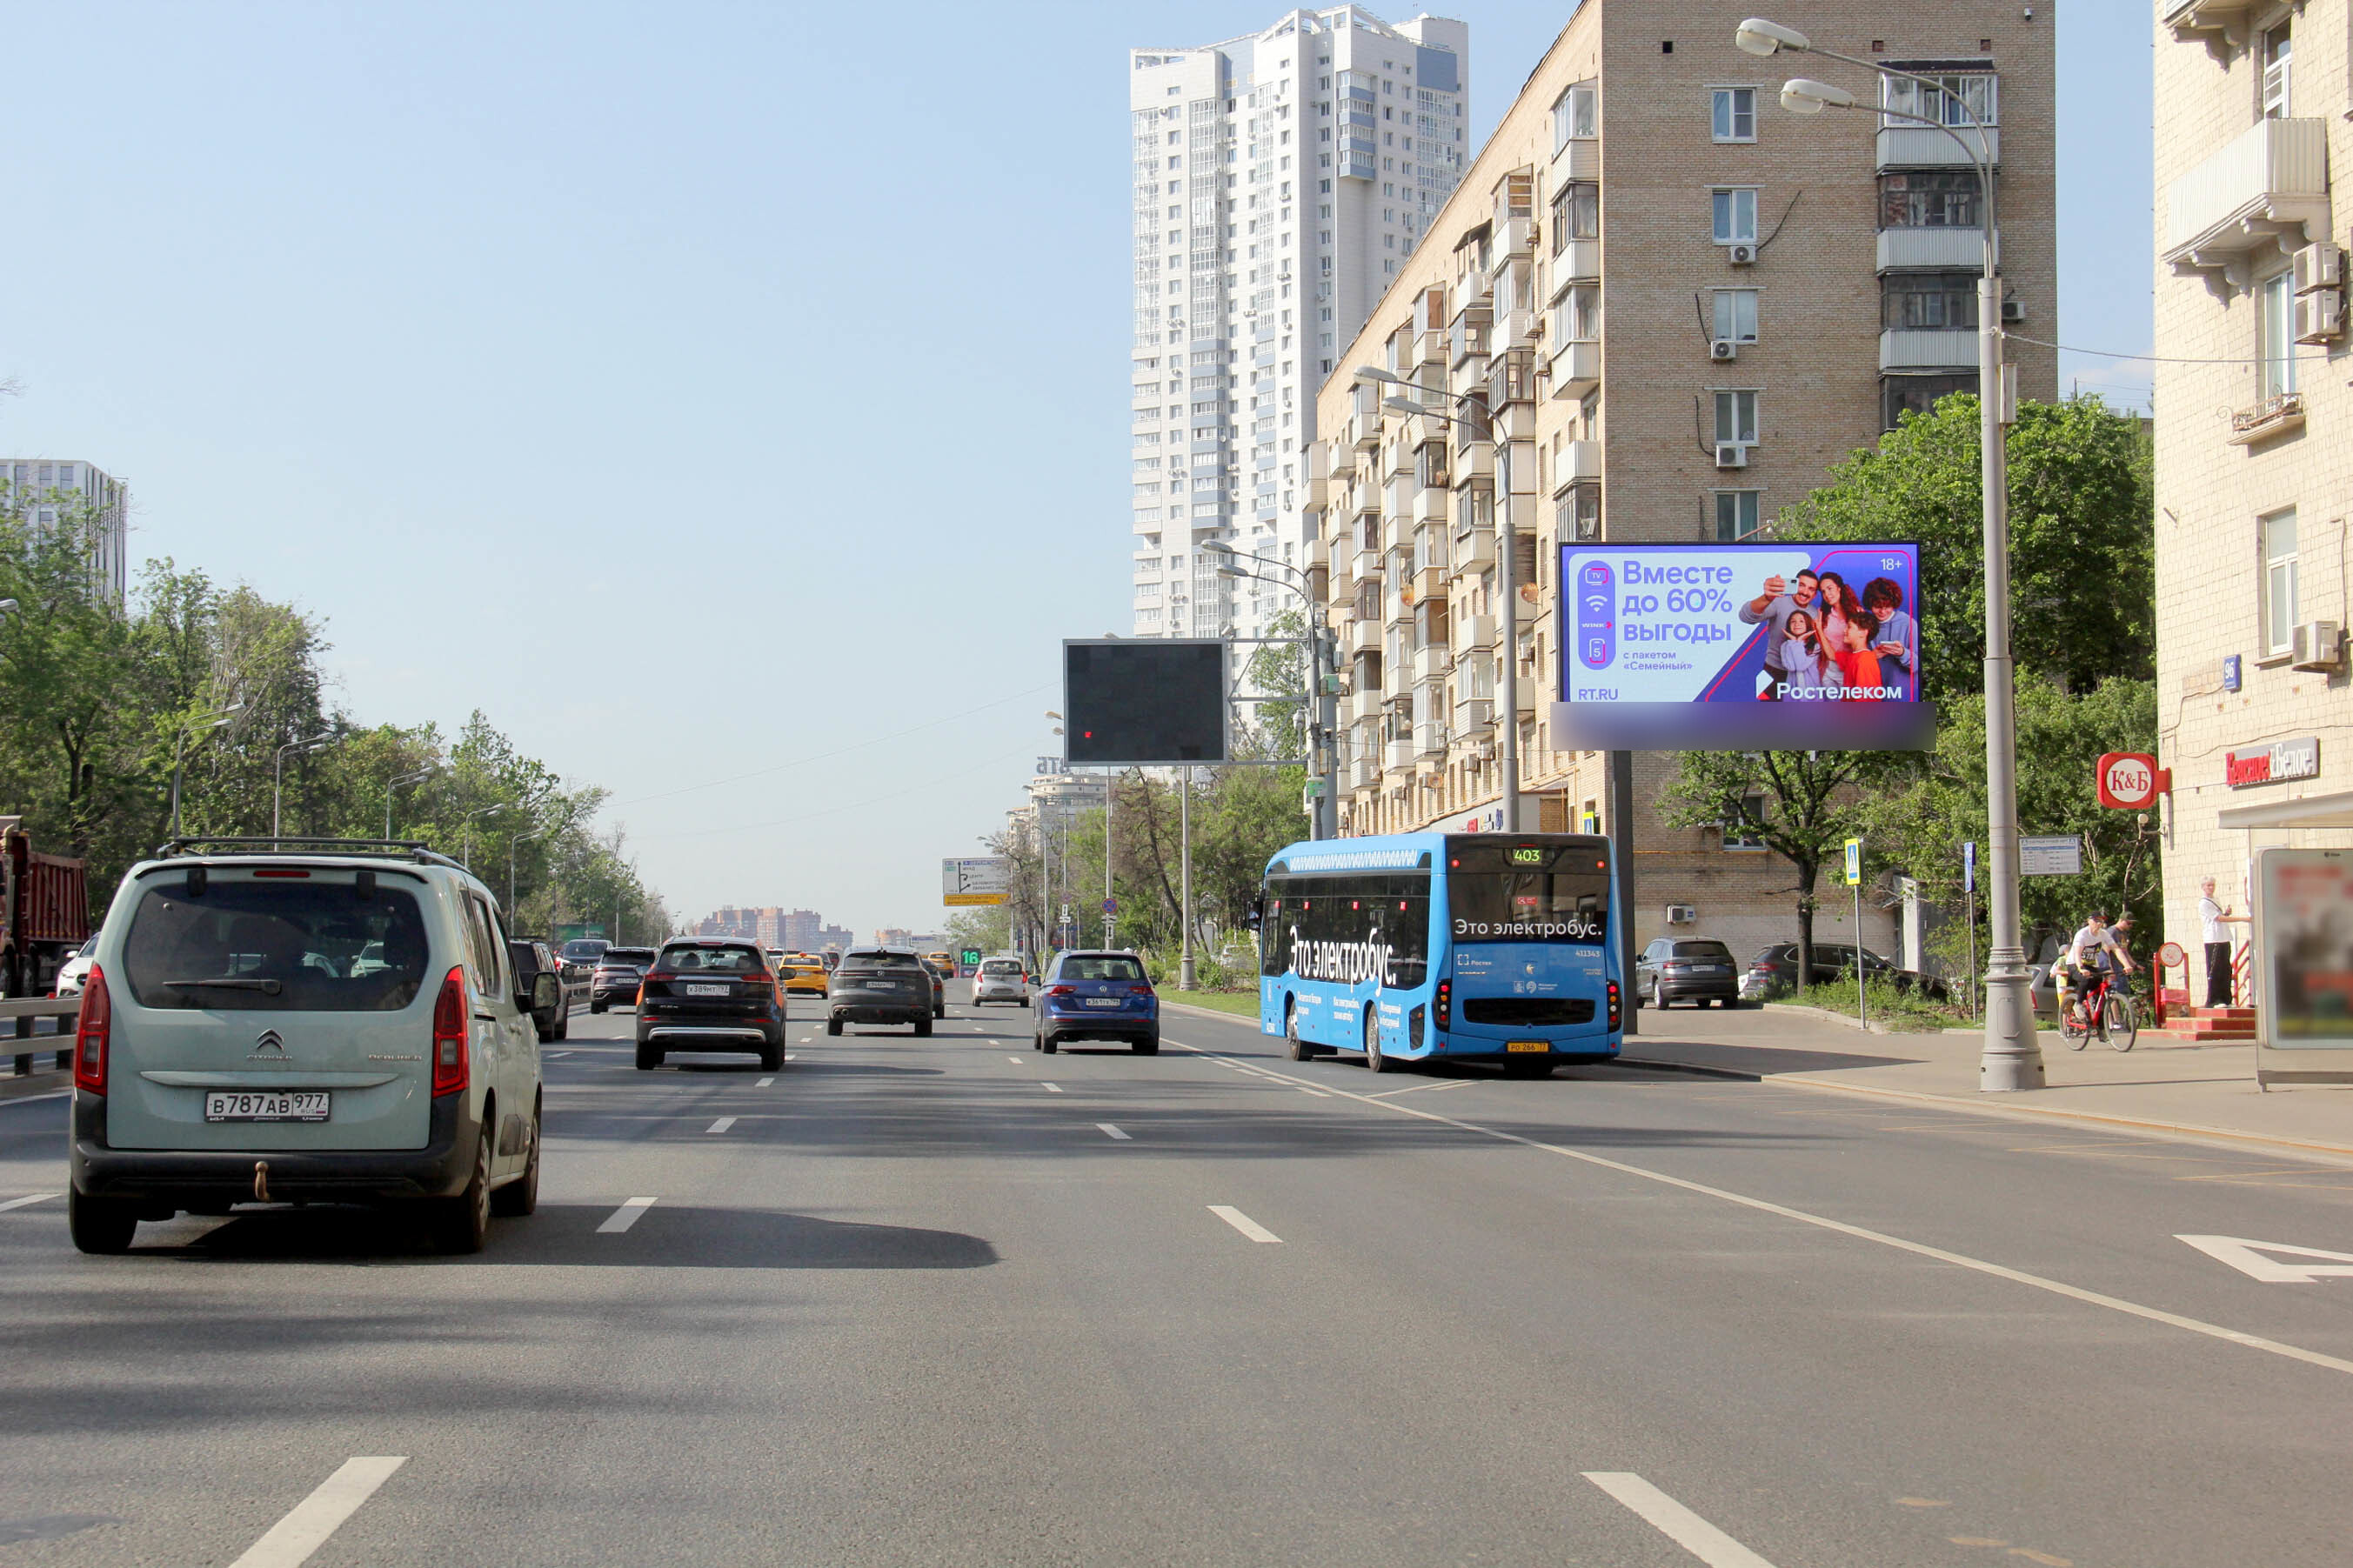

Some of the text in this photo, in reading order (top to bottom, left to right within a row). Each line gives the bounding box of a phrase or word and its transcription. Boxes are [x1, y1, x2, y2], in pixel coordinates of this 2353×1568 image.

[1623, 560, 1733, 584] Вместе
[1880, 557, 1902, 570] 18+
[1622, 588, 1733, 617] до 60%
[1623, 623, 1731, 644] выгоды
[1593, 648, 1601, 657] 5
[1623, 661, 1693, 671] «Семейный»
[2225, 661, 2235, 679] 96
[1578, 688, 1619, 701] RT.RU
[1776, 682, 1902, 699] Ростелеком
[2111, 770, 2149, 791] К&Б
[1514, 850, 1540, 862] 403
[1454, 918, 1602, 939] Это электробус.
[1288, 924, 1397, 998] Это электробус.
[213, 1094, 324, 1114] В787АВ 977
